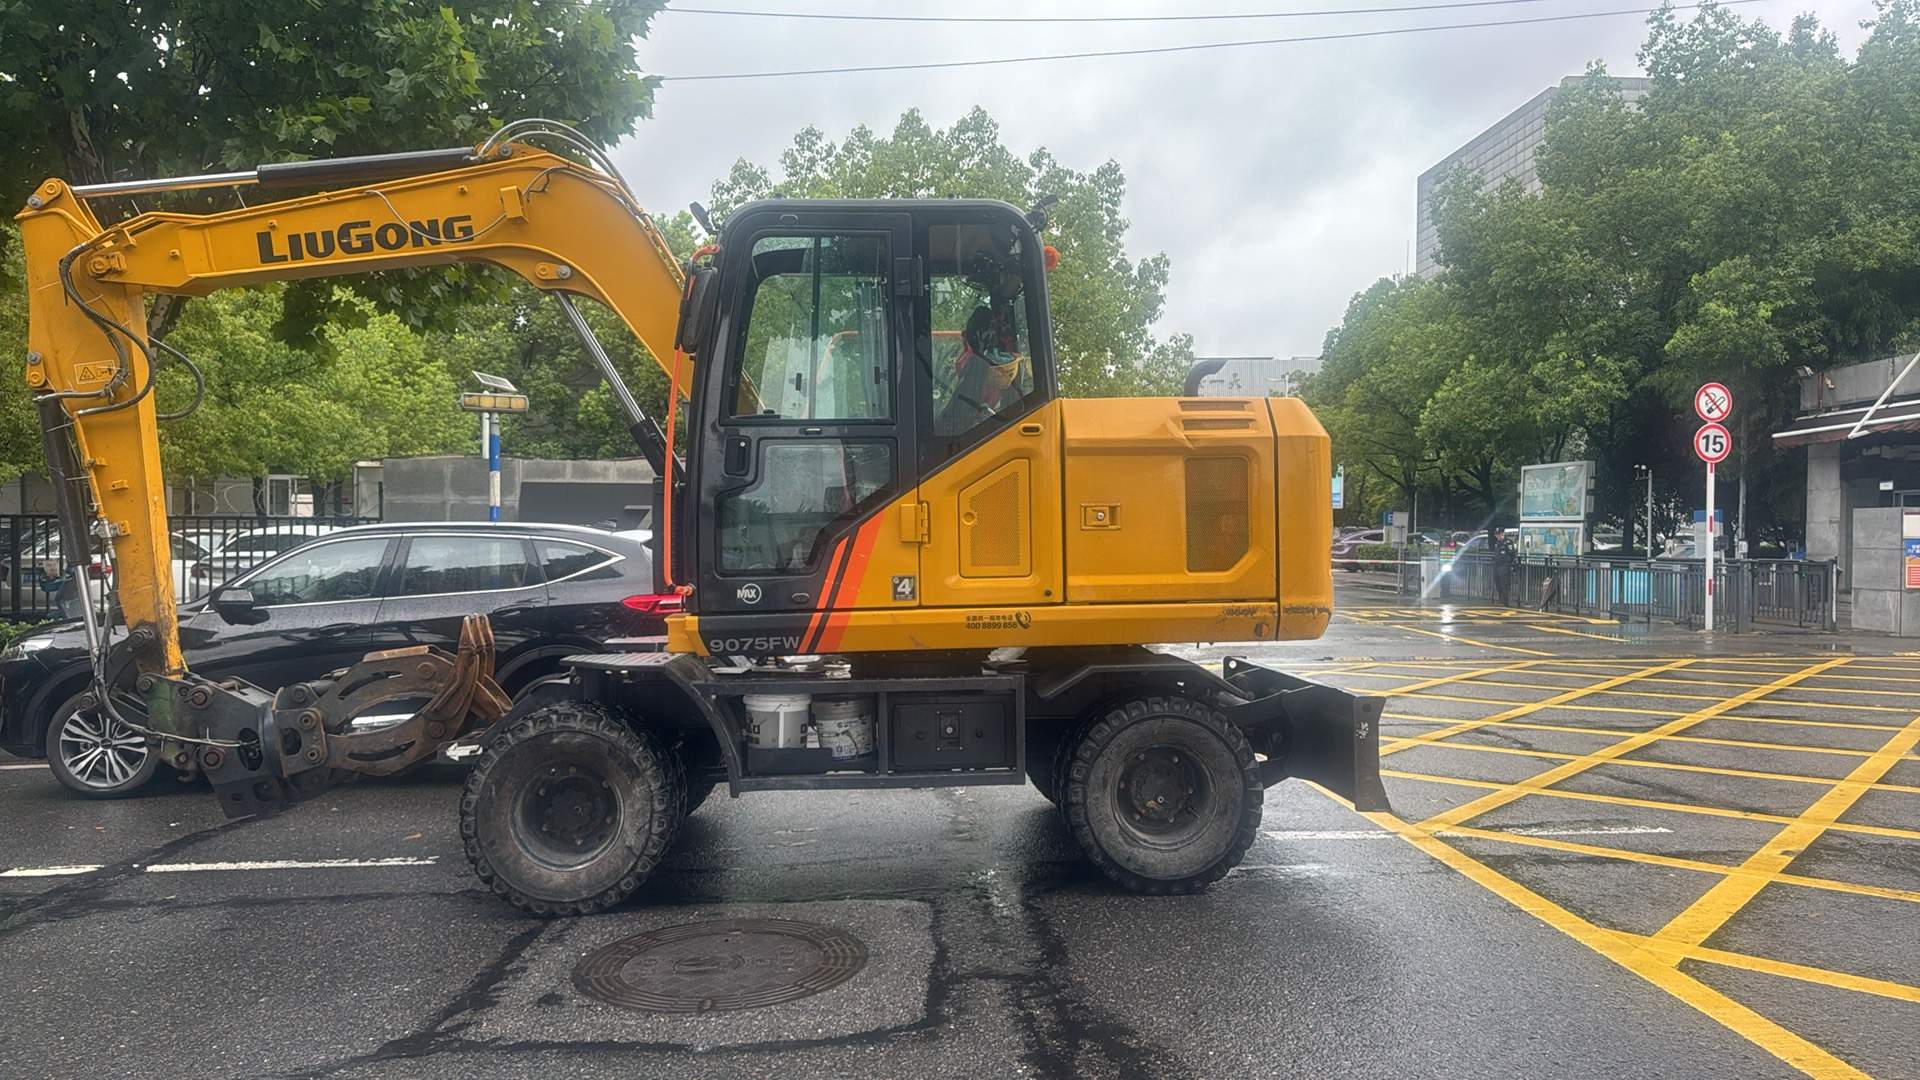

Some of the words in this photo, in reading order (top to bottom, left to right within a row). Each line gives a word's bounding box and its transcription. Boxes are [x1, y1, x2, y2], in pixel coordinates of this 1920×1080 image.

[1702, 434, 1724, 453] 15
[737, 588, 757, 599] MAX
[897, 578, 911, 595] 4
[710, 636, 800, 653] 9075FW
